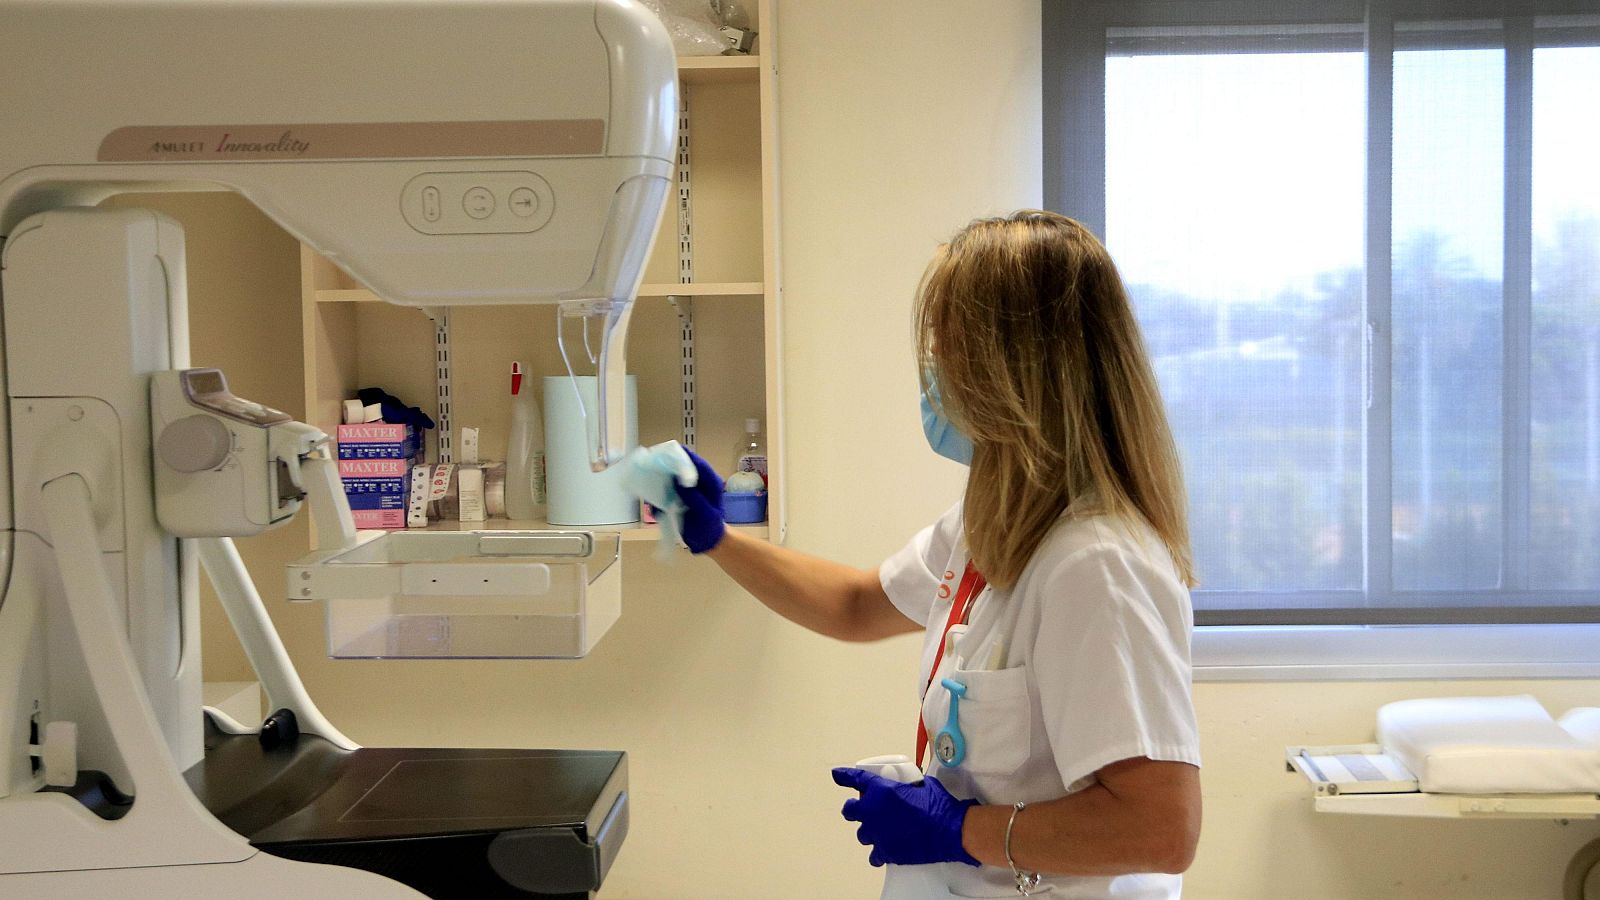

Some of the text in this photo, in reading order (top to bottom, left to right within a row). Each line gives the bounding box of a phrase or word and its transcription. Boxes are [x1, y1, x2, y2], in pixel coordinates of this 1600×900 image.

[215, 130, 309, 155] Innovality
[341, 427, 397, 438] MAXTER
[342, 462, 398, 473] MAXTER
